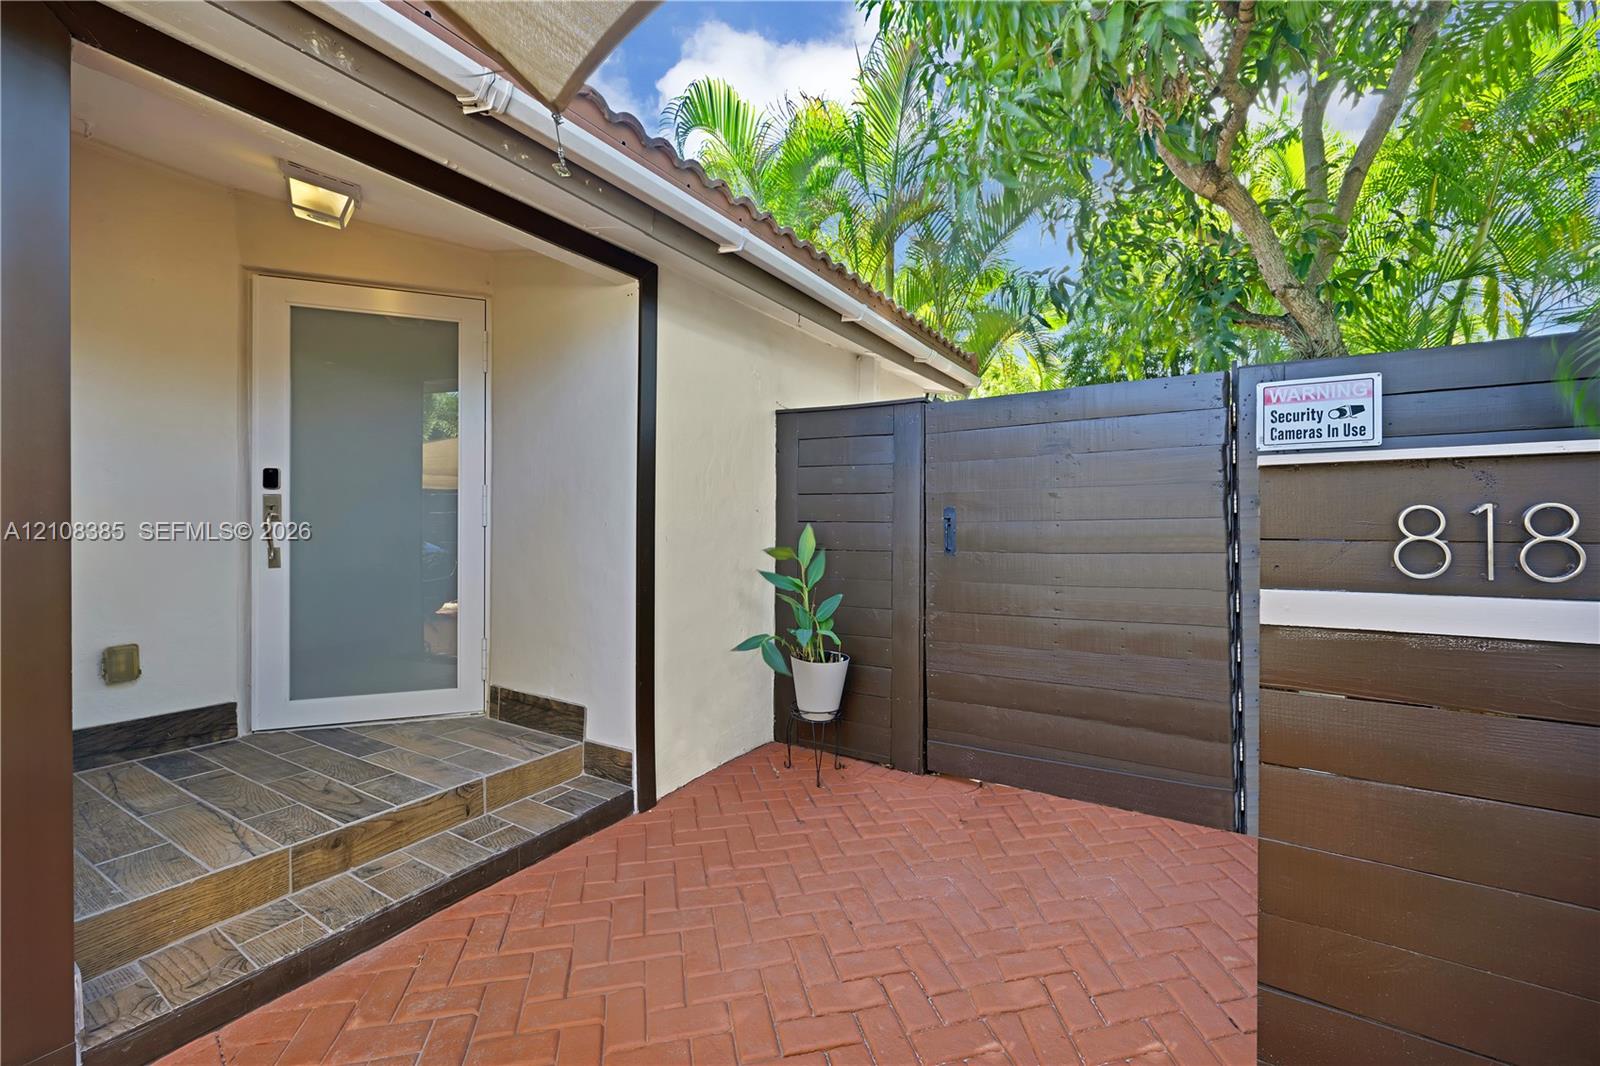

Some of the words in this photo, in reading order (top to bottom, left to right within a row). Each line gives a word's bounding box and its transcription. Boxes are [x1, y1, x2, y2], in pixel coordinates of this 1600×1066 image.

[1269, 382, 1368, 403] WARNING
[1270, 408, 1323, 424] Security
[1270, 427, 1323, 441] Cameras
[1327, 424, 1339, 438] In
[1343, 423, 1366, 437] Use
[1394, 502, 1587, 583] 818
